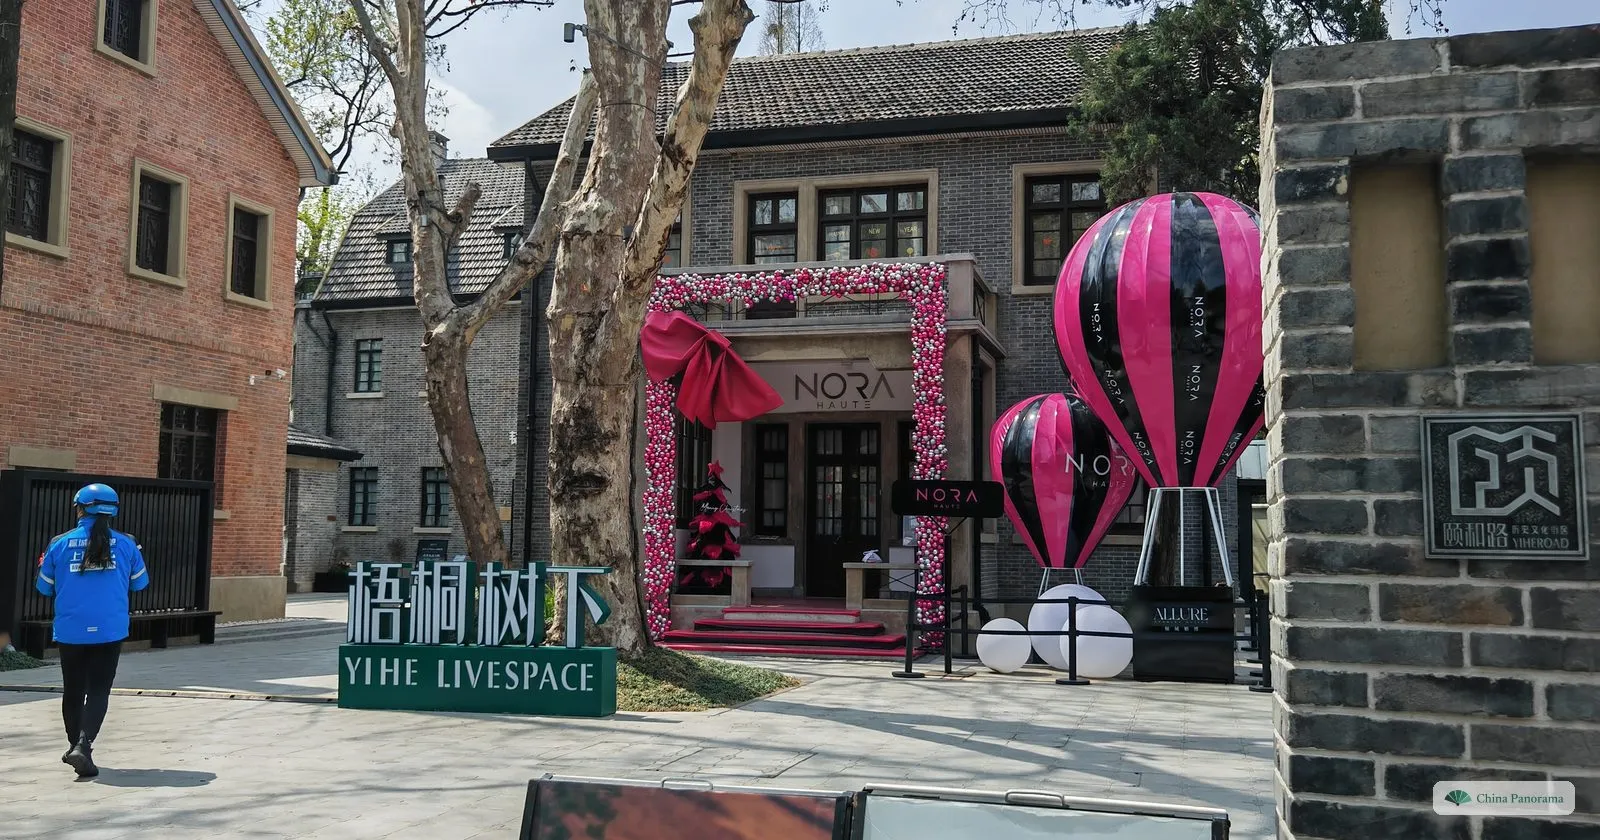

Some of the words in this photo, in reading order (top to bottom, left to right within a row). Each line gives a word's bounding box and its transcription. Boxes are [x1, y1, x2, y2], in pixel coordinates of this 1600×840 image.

[1093, 303, 1103, 343] NORA
[1194, 296, 1204, 337] NORA
[795, 372, 896, 400] NORA
[1105, 370, 1125, 404] NORA
[1190, 365, 1200, 401] NORA
[817, 401, 871, 409] HAUTE
[1133, 432, 1154, 465] NORA
[1183, 431, 1195, 465] NORA
[1219, 432, 1243, 466] NORA
[916, 488, 978, 502] NORA
[1443, 522, 1508, 548] 颐和路
[1512, 537, 1569, 549] YIHEROAD
[347, 560, 605, 648] 梧桐树下
[1153, 607, 1209, 620] ALLURE
[344, 656, 418, 686] YIHE
[437, 659, 594, 692] LIVESPACE
